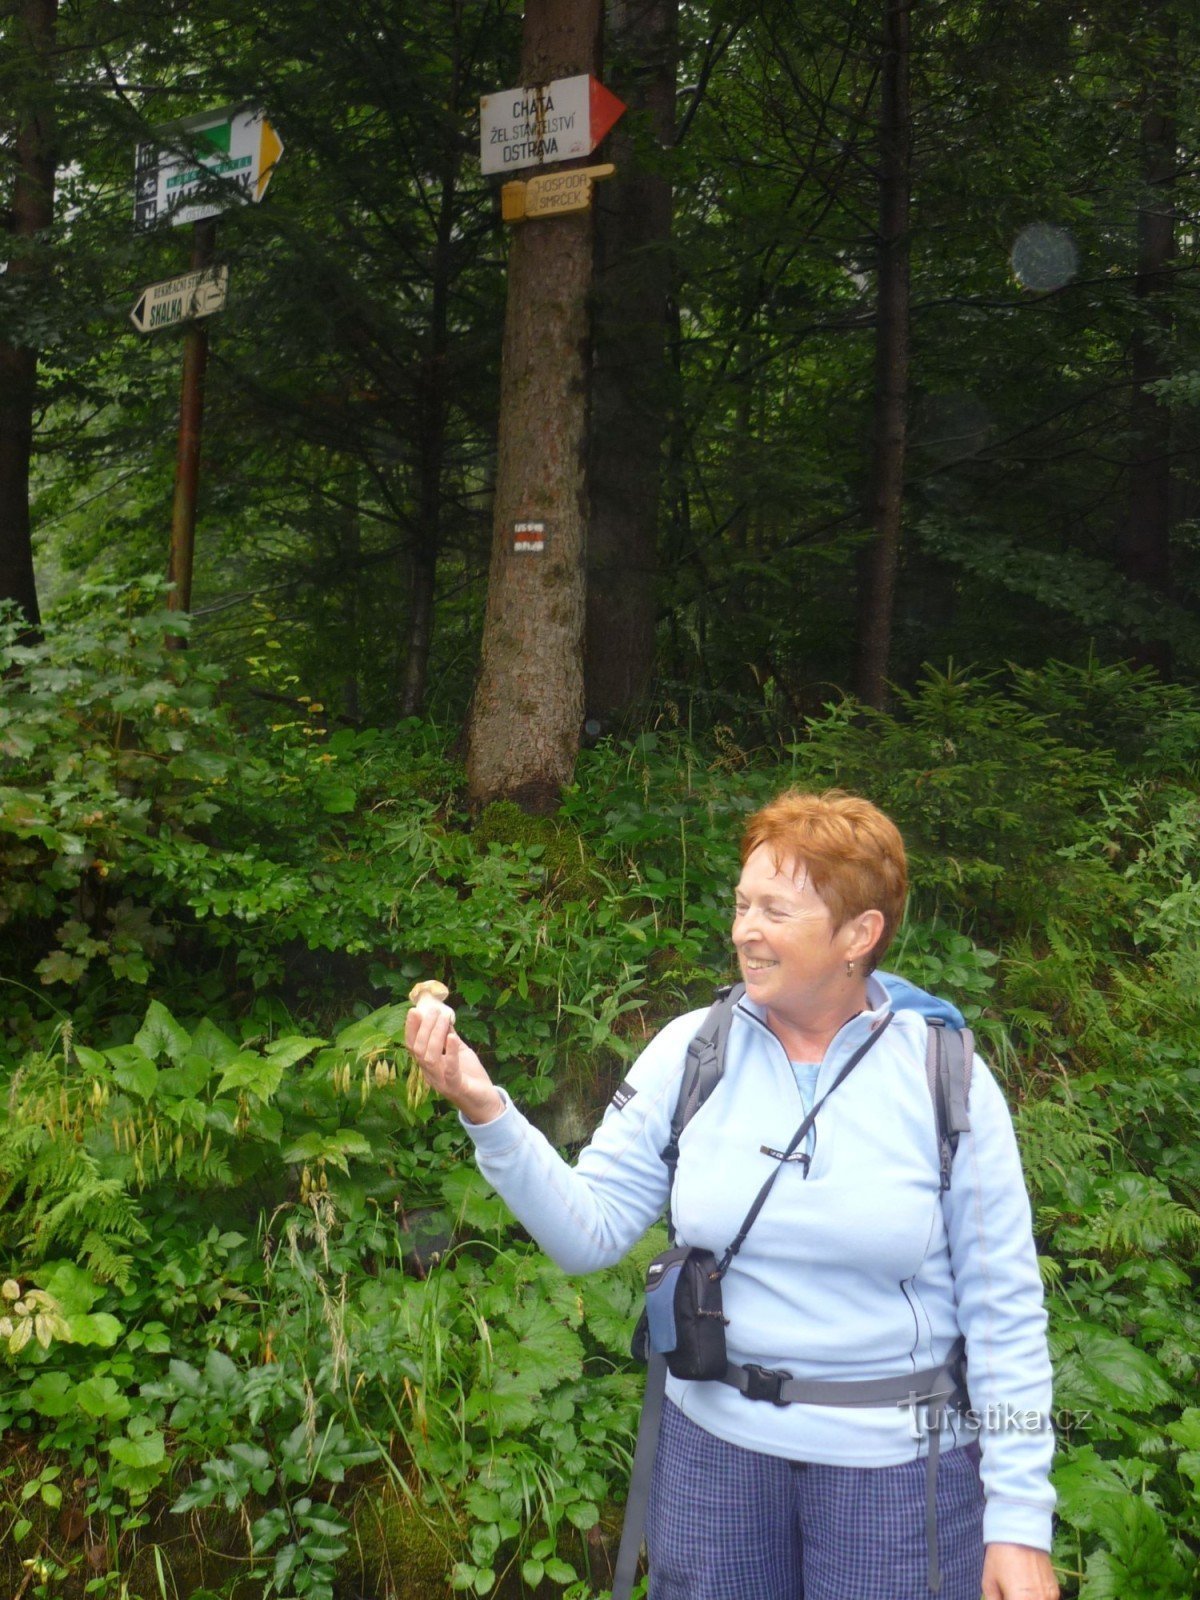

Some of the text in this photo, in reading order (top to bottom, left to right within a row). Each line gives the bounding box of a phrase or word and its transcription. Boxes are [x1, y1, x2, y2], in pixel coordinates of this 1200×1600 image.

[513, 95, 554, 118] CHATA
[503, 138, 558, 163] OSTRAVA
[537, 173, 587, 193] HOSPODA
[149, 296, 182, 328] SKALKA
